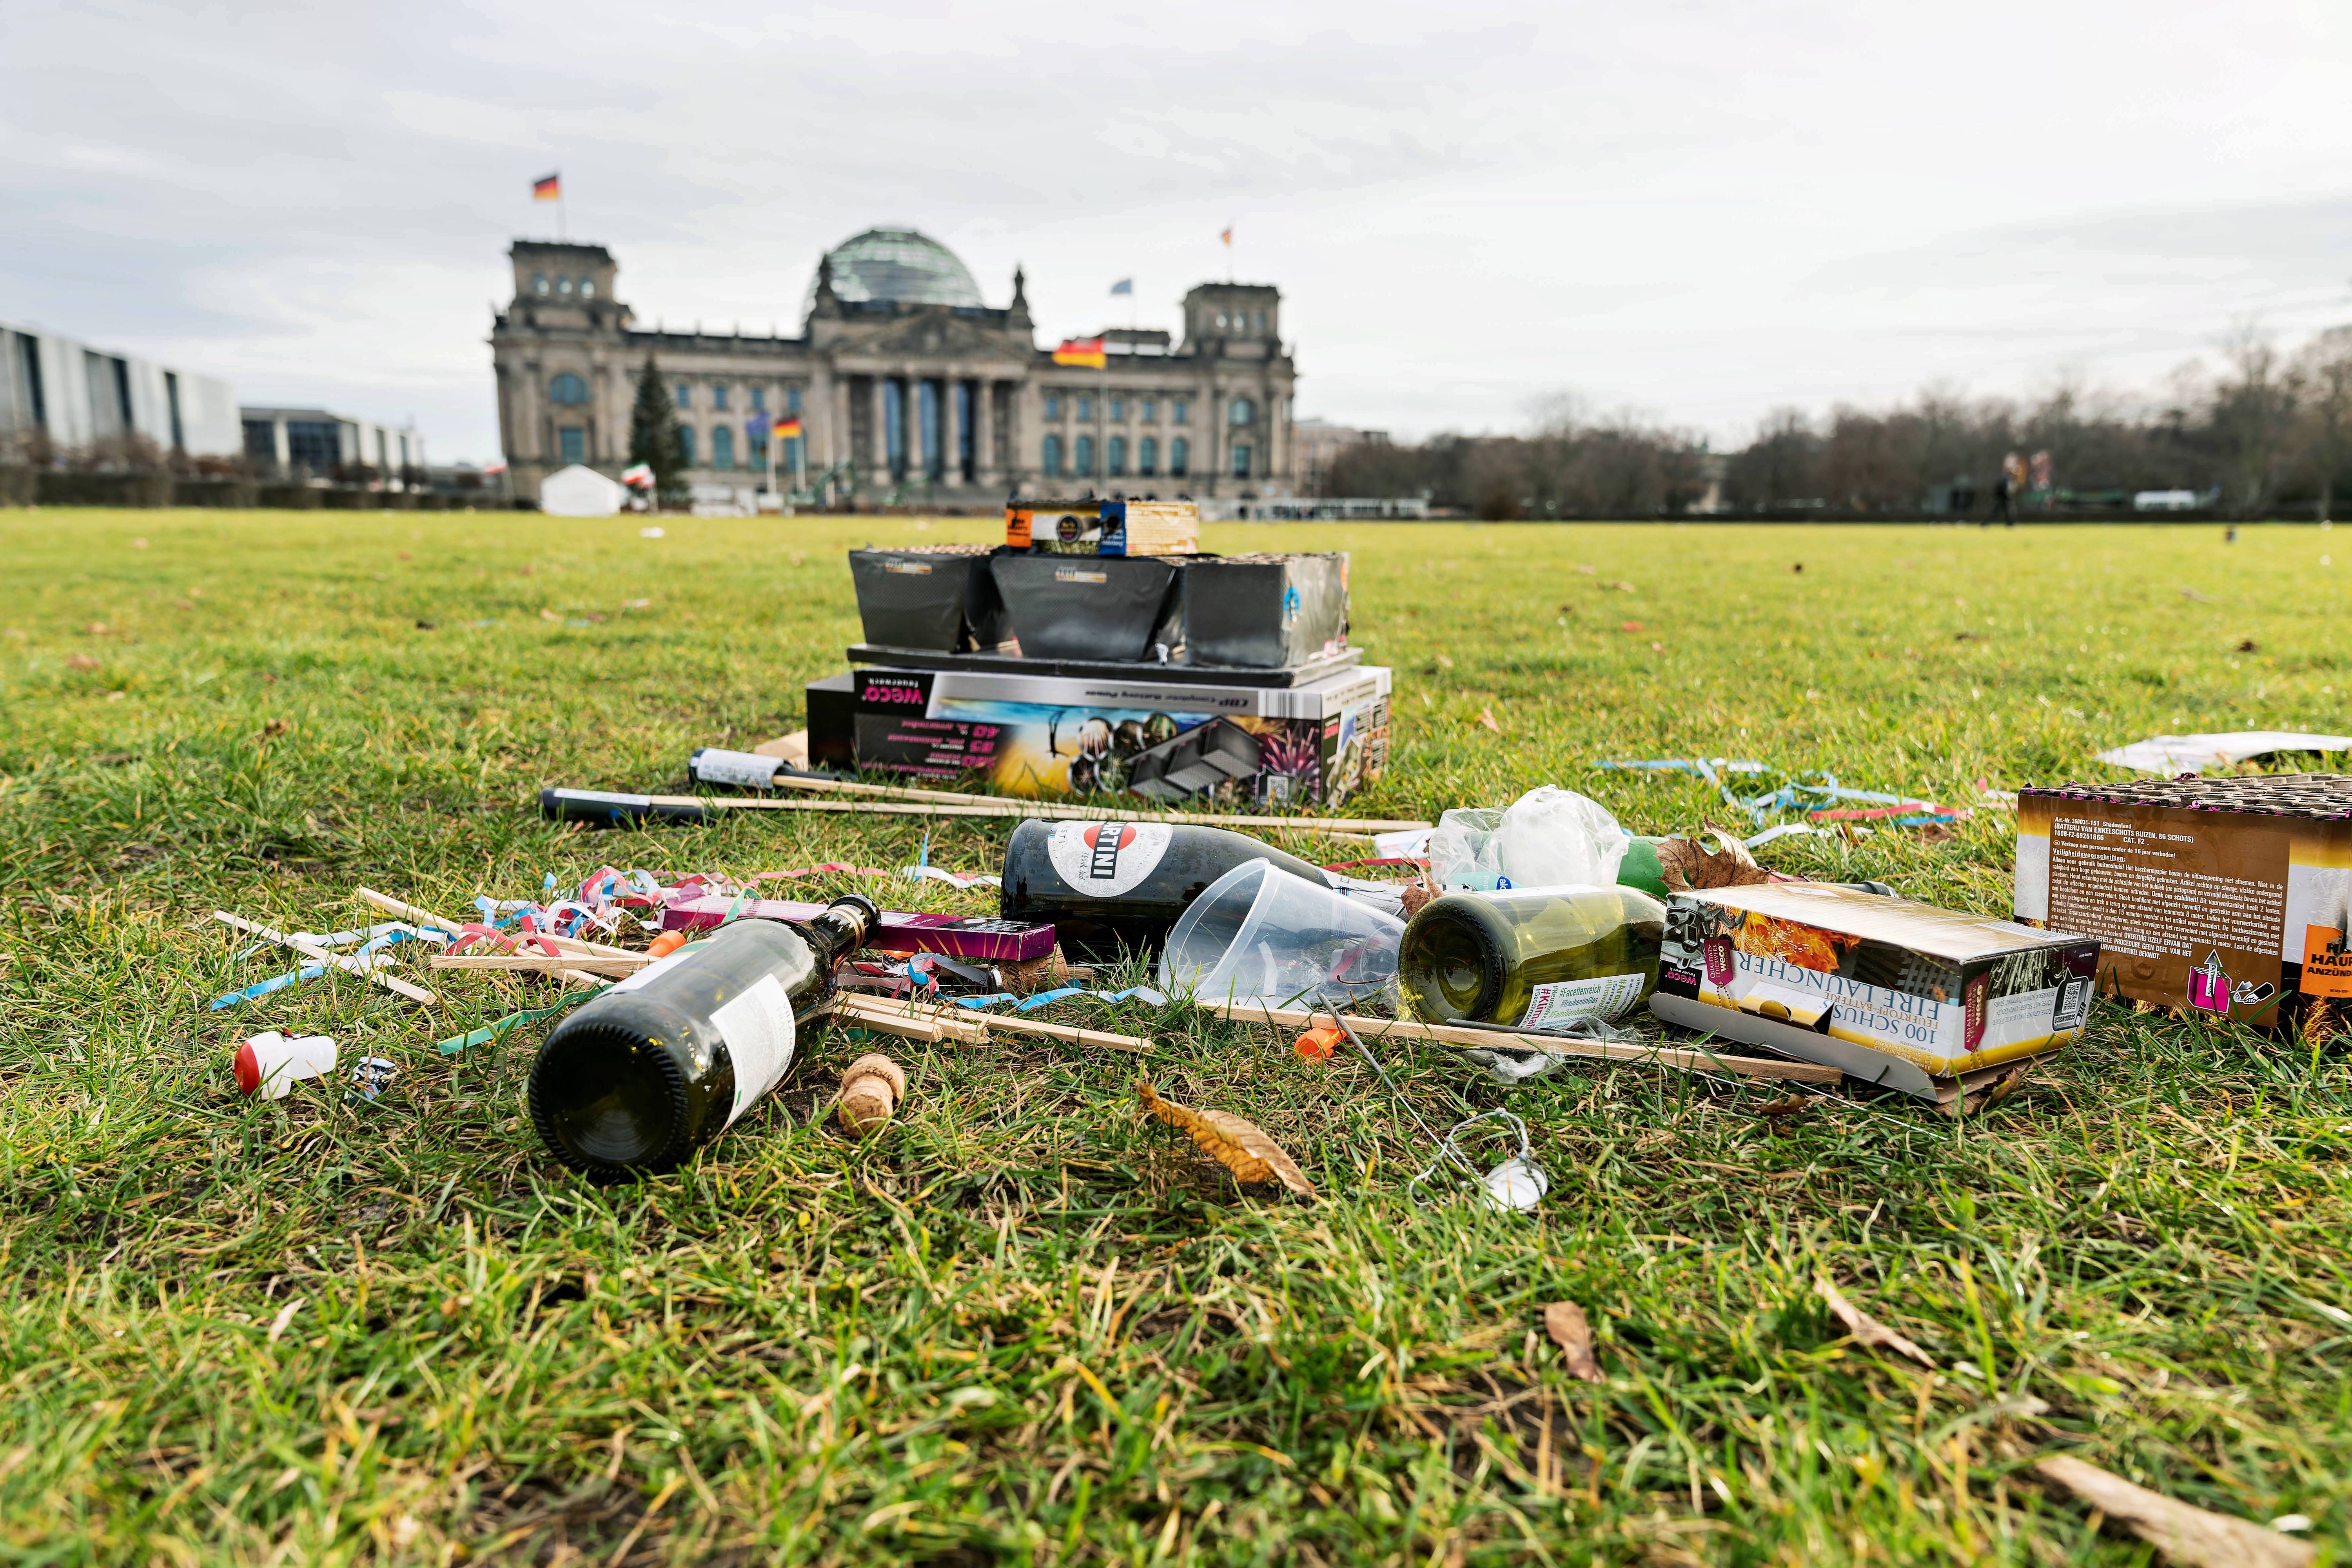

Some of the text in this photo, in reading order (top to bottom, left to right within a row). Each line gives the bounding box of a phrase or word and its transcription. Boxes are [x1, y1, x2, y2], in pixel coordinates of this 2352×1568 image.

[865, 686, 924, 705] weco
[2054, 823, 2080, 831] (BATTERIJ
[2094, 827, 2134, 836] ENKELSCHOTS
[2167, 834, 2194, 843] SCHOTS)
[2054, 830, 2104, 840] 1008-F2-69251866
[1093, 822, 1127, 875] ARTINI
[2053, 848, 2126, 862] Veiligheidsvoorschriften:
[2097, 861, 2124, 869] buitenshuis!
[2134, 865, 2167, 875] beschermpapier
[2191, 873, 2223, 883] uitlaatopening
[2082, 874, 2099, 883] rekening
[2114, 878, 2132, 887] zichtzijde
[2173, 887, 2197, 896] pictogram)
[2221, 892, 2243, 901] obstakels
[2135, 873, 2156, 882] dergelijke
[2196, 882, 2212, 890] rechtop
[2256, 889, 2282, 898] ondergrond
[2209, 900, 2245, 909] vuurwerkartikel
[1668, 971, 1697, 985] weco
[1670, 967, 1695, 977] feuerwerk
[1737, 952, 1873, 1002] LAUNCHER
[2307, 967, 2352, 976] ANZÜND
[1559, 984, 1601, 998] #Facettenreich
[1540, 985, 1558, 1022] #NeueReben
[1560, 996, 1598, 1007] #TraubenimGlas
[1824, 992, 1938, 1029] FEUERTOPF-BATTERIE
[1882, 989, 1939, 1021] FIRE
[1548, 1005, 1595, 1019] #Familienbetrieb
[1905, 1023, 1936, 1044] 100
